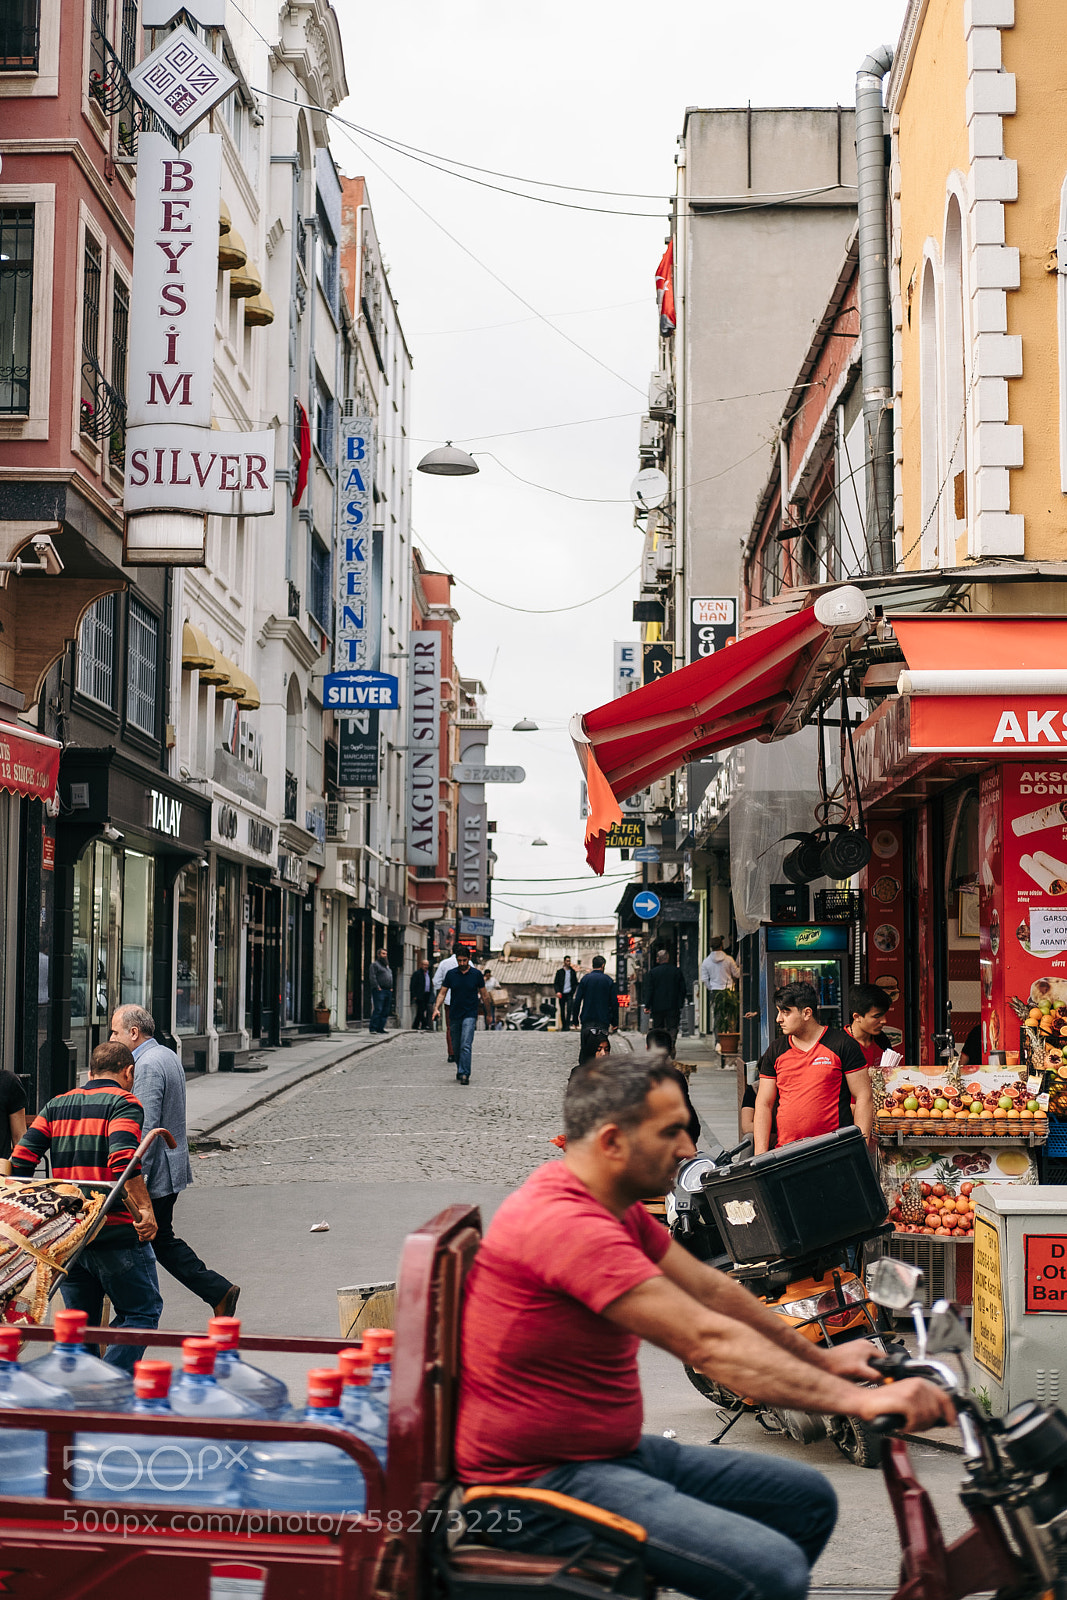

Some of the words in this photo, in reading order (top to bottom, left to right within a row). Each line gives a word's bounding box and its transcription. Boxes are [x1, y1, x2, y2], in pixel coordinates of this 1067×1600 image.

[146, 160, 194, 406] BEYSİM
[129, 448, 269, 492] SILVER
[342, 436, 366, 663] BAŞKENT
[699, 612, 727, 622] HAN
[328, 686, 393, 704] SILVER
[412, 641, 435, 741] SILVER
[992, 710, 1067, 743] AK
[1, 762, 11, 779] 12
[151, 789, 183, 838] TALAY
[463, 814, 482, 895] SILVER
[1043, 1264, 1067, 1280] Ot
